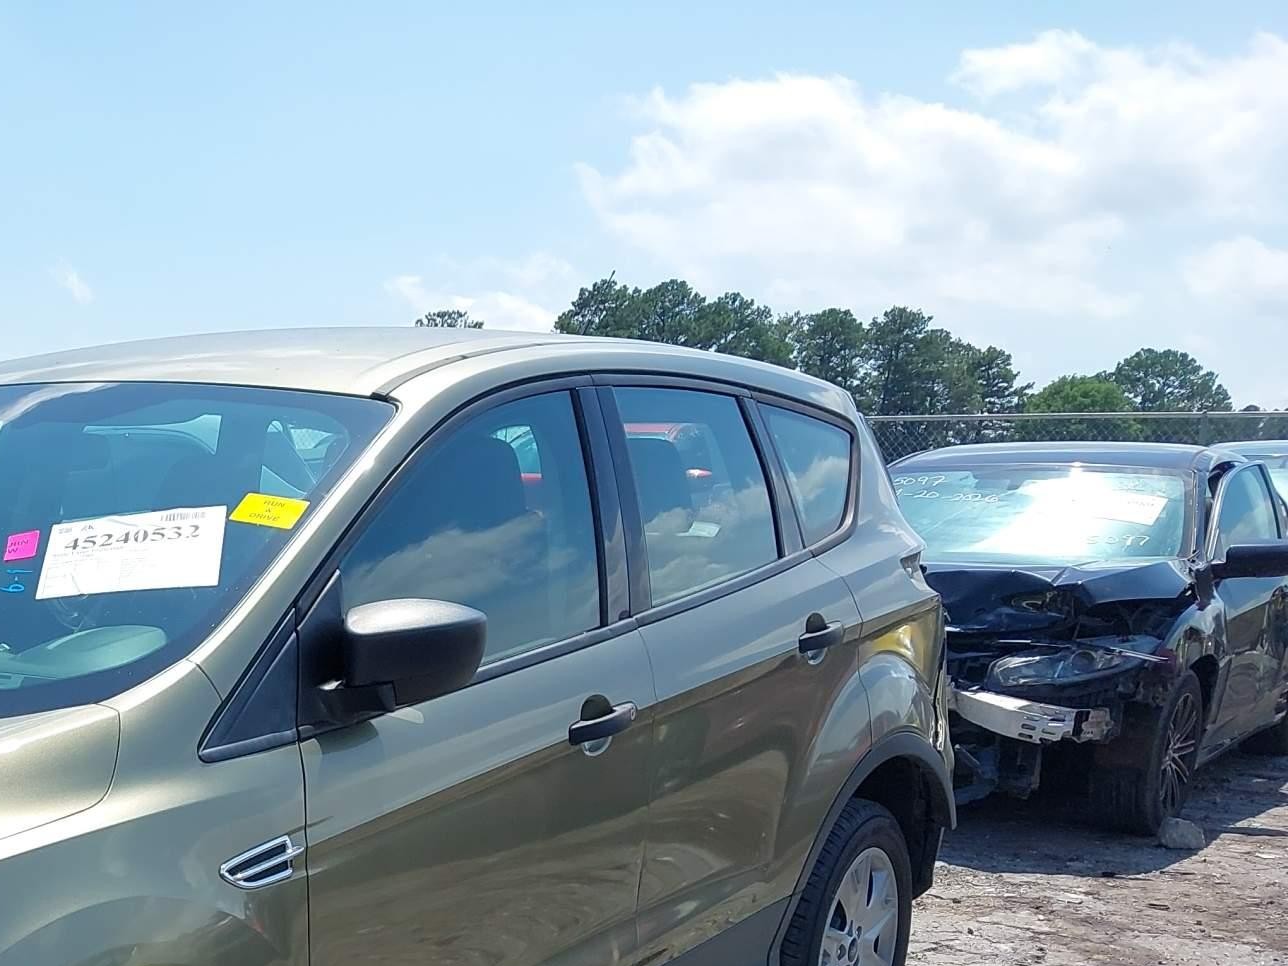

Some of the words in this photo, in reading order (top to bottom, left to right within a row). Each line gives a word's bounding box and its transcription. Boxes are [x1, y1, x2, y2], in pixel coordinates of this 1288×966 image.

[263, 500, 286, 508] RUN
[248, 512, 281, 522] DRIVE
[64, 524, 201, 551] 45240532
